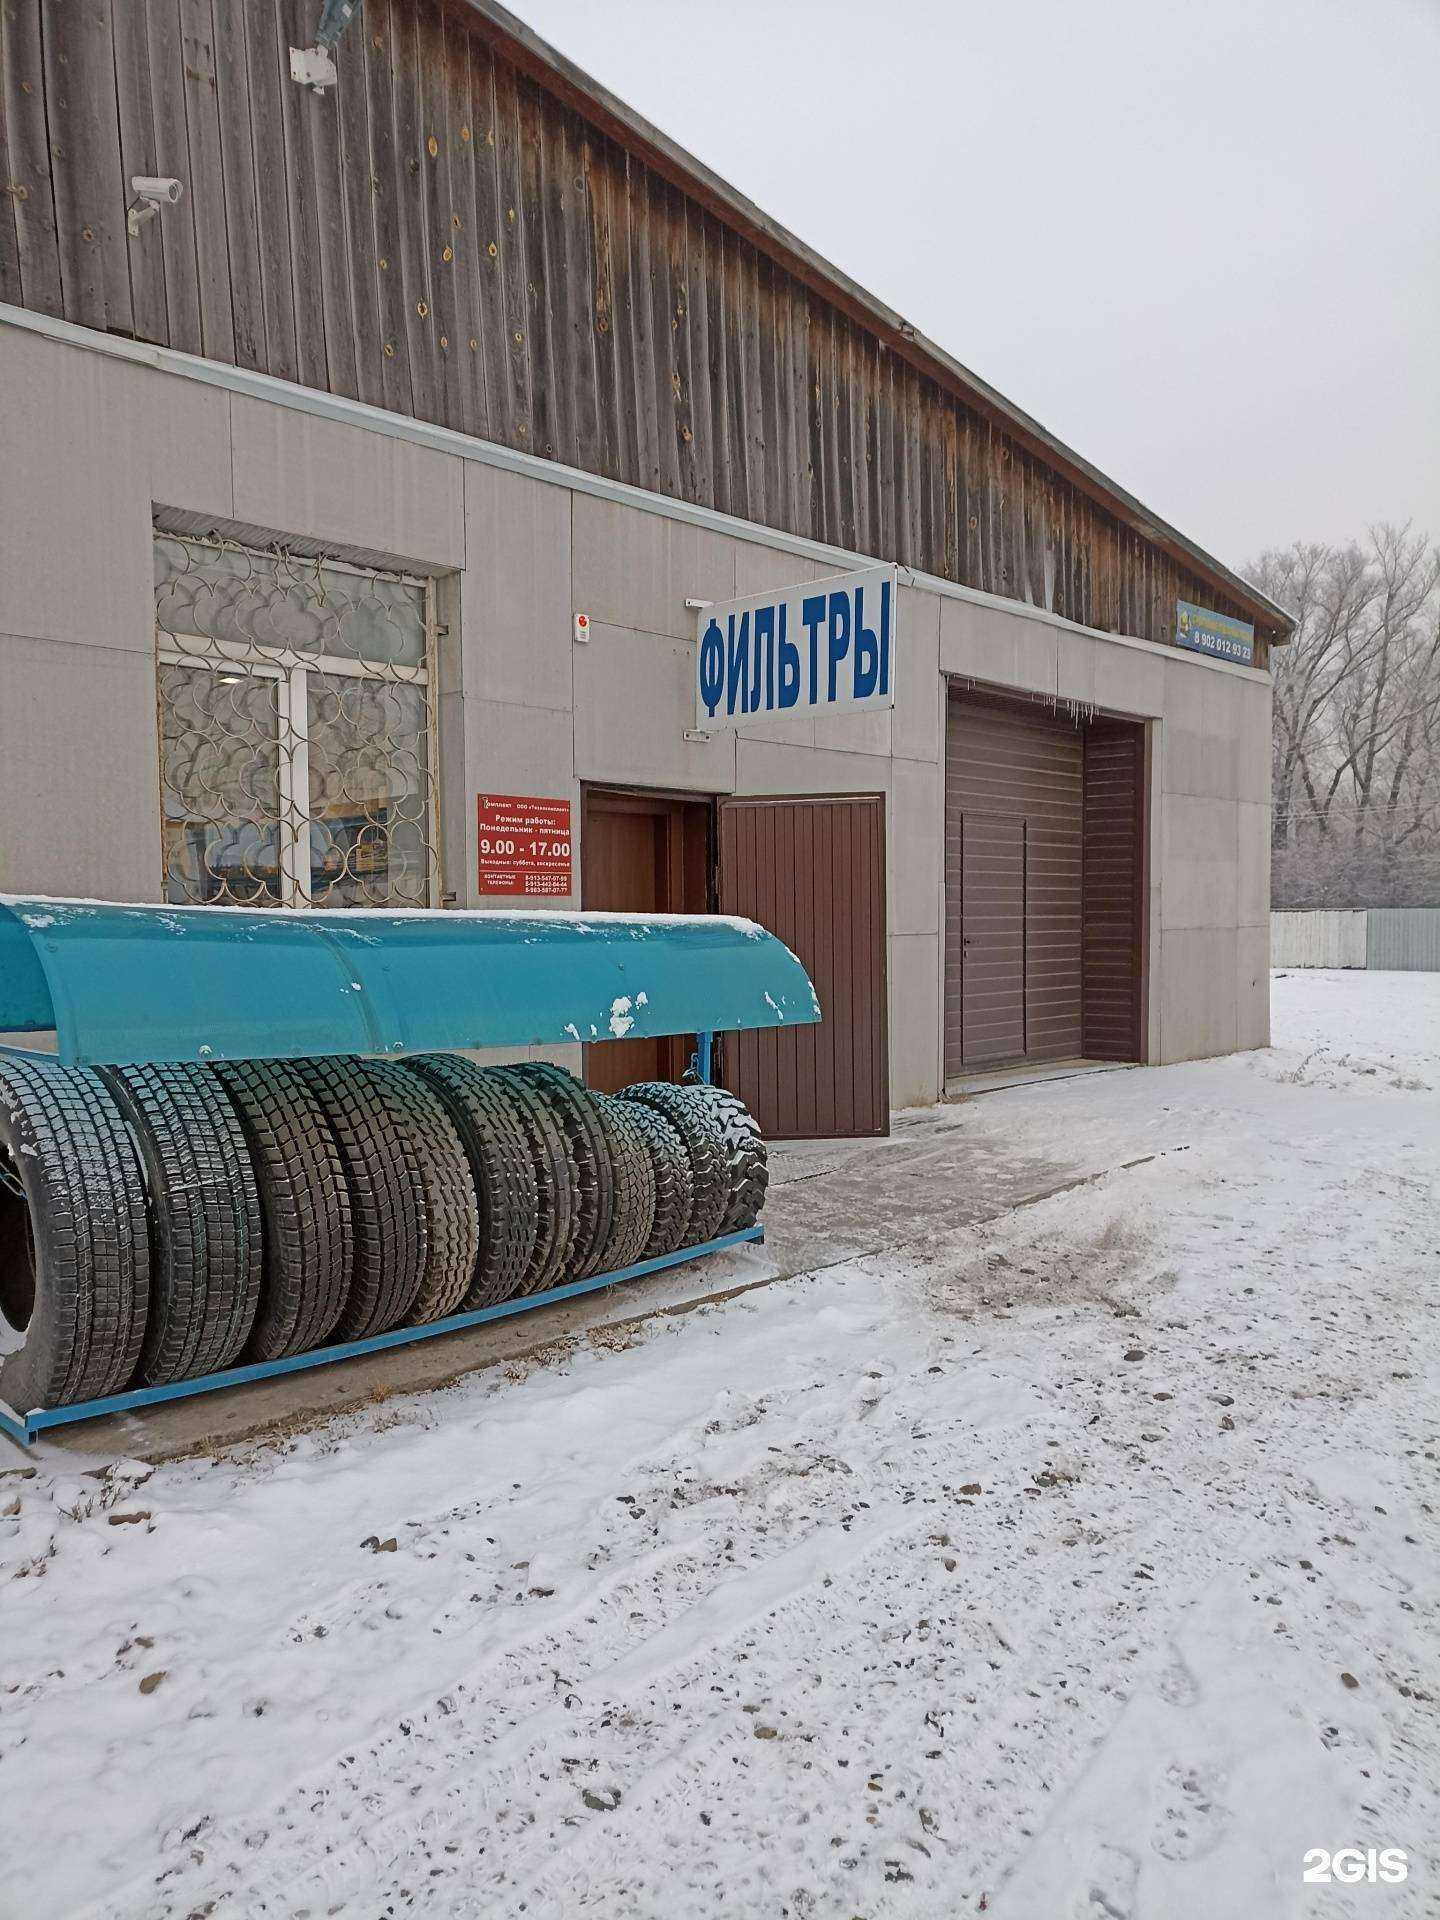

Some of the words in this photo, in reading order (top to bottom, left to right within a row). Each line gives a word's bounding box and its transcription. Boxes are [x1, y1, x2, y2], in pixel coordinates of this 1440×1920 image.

[700, 582, 891, 718] ФИЛЬТРЫ
[1194, 631, 1200, 643] 8
[1201, 634, 1215, 649] 902
[1216, 638, 1231, 653] 012
[1232, 643, 1241, 657] 93
[480, 823, 533, 834] Понедельник
[539, 828, 570, 836] пятница
[495, 814, 523, 823] Режим
[525, 817, 556, 826] работы:
[480, 838, 515, 855] 9.00
[529, 841, 571, 857] 17.00
